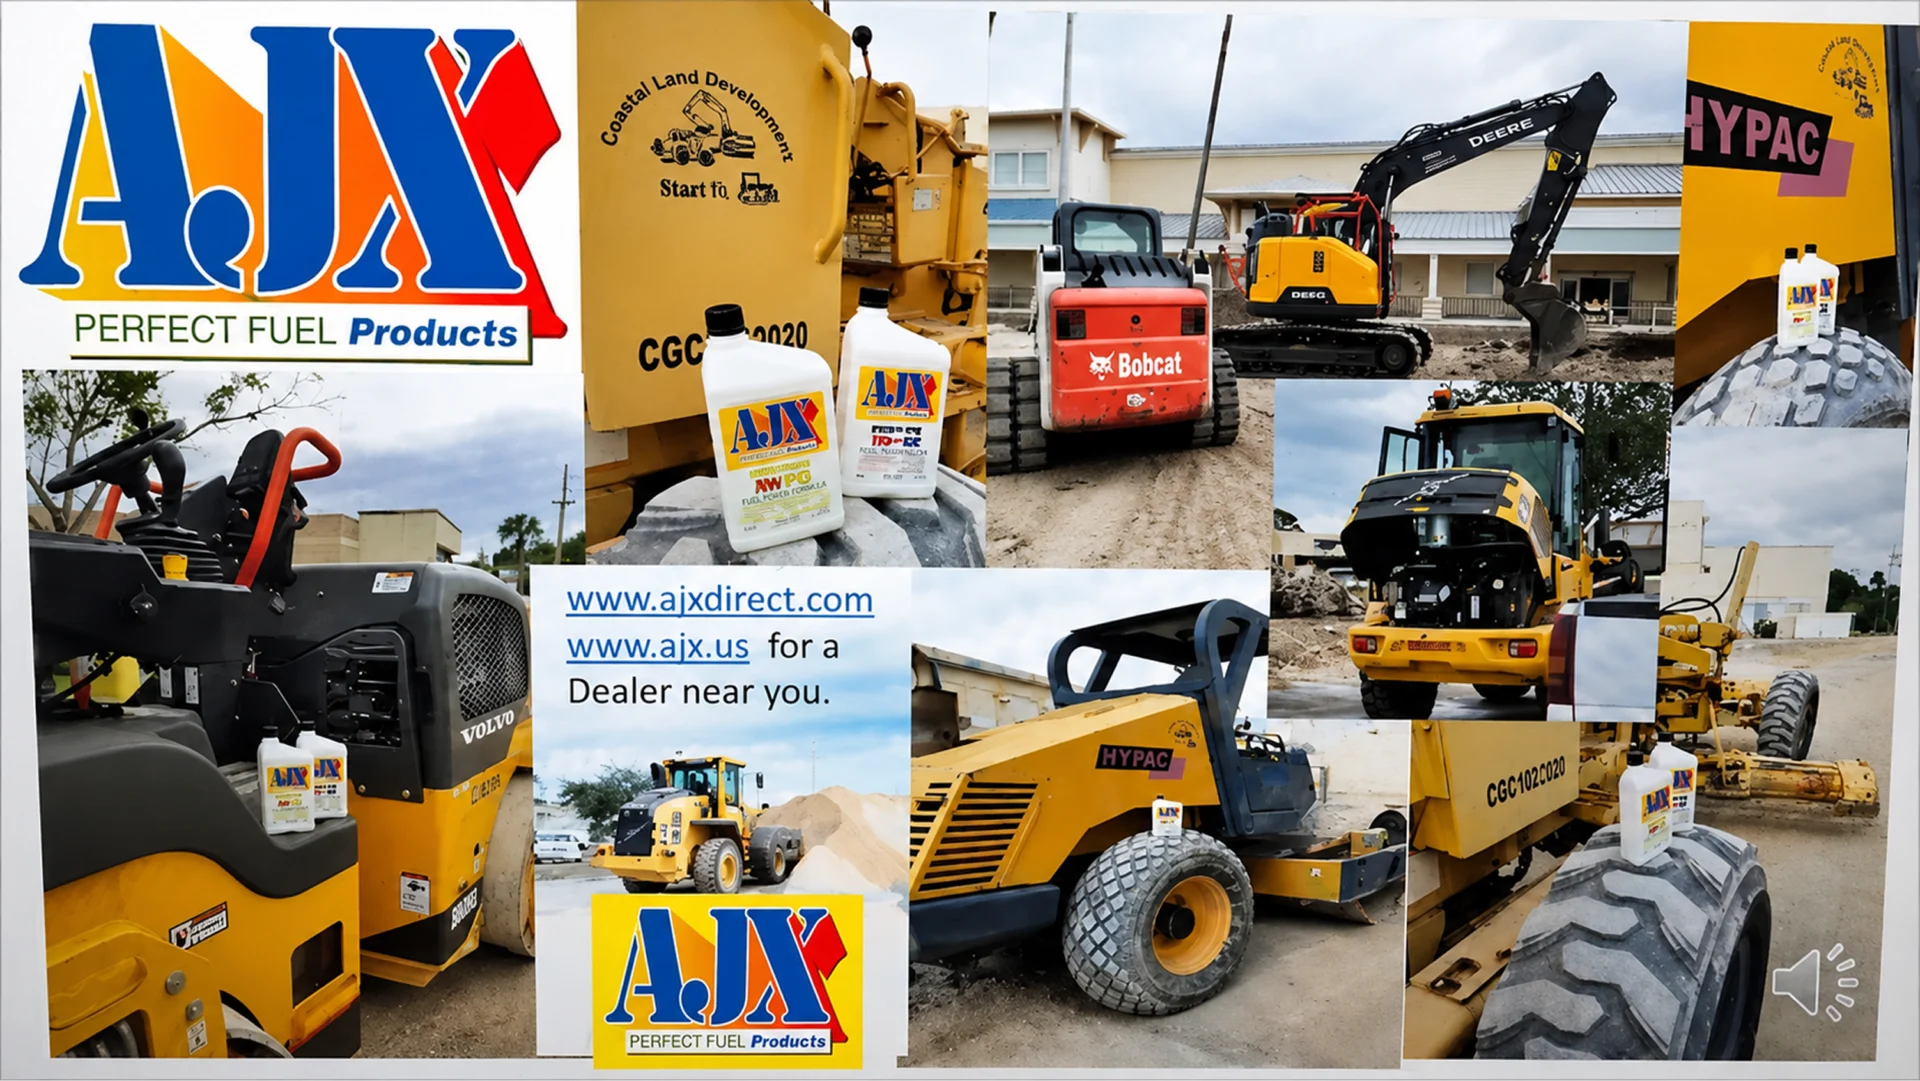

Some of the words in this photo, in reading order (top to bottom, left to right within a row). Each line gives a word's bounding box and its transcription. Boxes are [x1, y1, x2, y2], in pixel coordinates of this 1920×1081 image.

[601, 81, 651, 147] Coastal
[652, 69, 699, 91] Land
[1468, 117, 1534, 148] DEERE
[1685, 94, 1820, 166] HYPAC
[18, 22, 529, 295] AJX
[660, 178, 706, 198] Start
[74, 313, 237, 343] PERFECT
[247, 316, 338, 345] FUEL
[348, 317, 519, 348] Products
[1118, 351, 1183, 378] Bobcat
[861, 370, 933, 410] AJX
[730, 397, 818, 454] AJX
[566, 584, 874, 618] www.ajxdirect.com
[566, 632, 750, 665] www.ajx.us
[768, 631, 813, 659] for
[823, 638, 839, 659] a
[569, 676, 672, 704] Dealer
[683, 684, 754, 704] near
[764, 684, 830, 711] you.
[460, 709, 514, 745] VOLVO
[1102, 747, 1169, 768] HYPAC
[604, 908, 830, 1026] AJX
[630, 1034, 702, 1049] PERFECT
[706, 1034, 746, 1049] FUEL
[750, 1034, 826, 1049] Products
